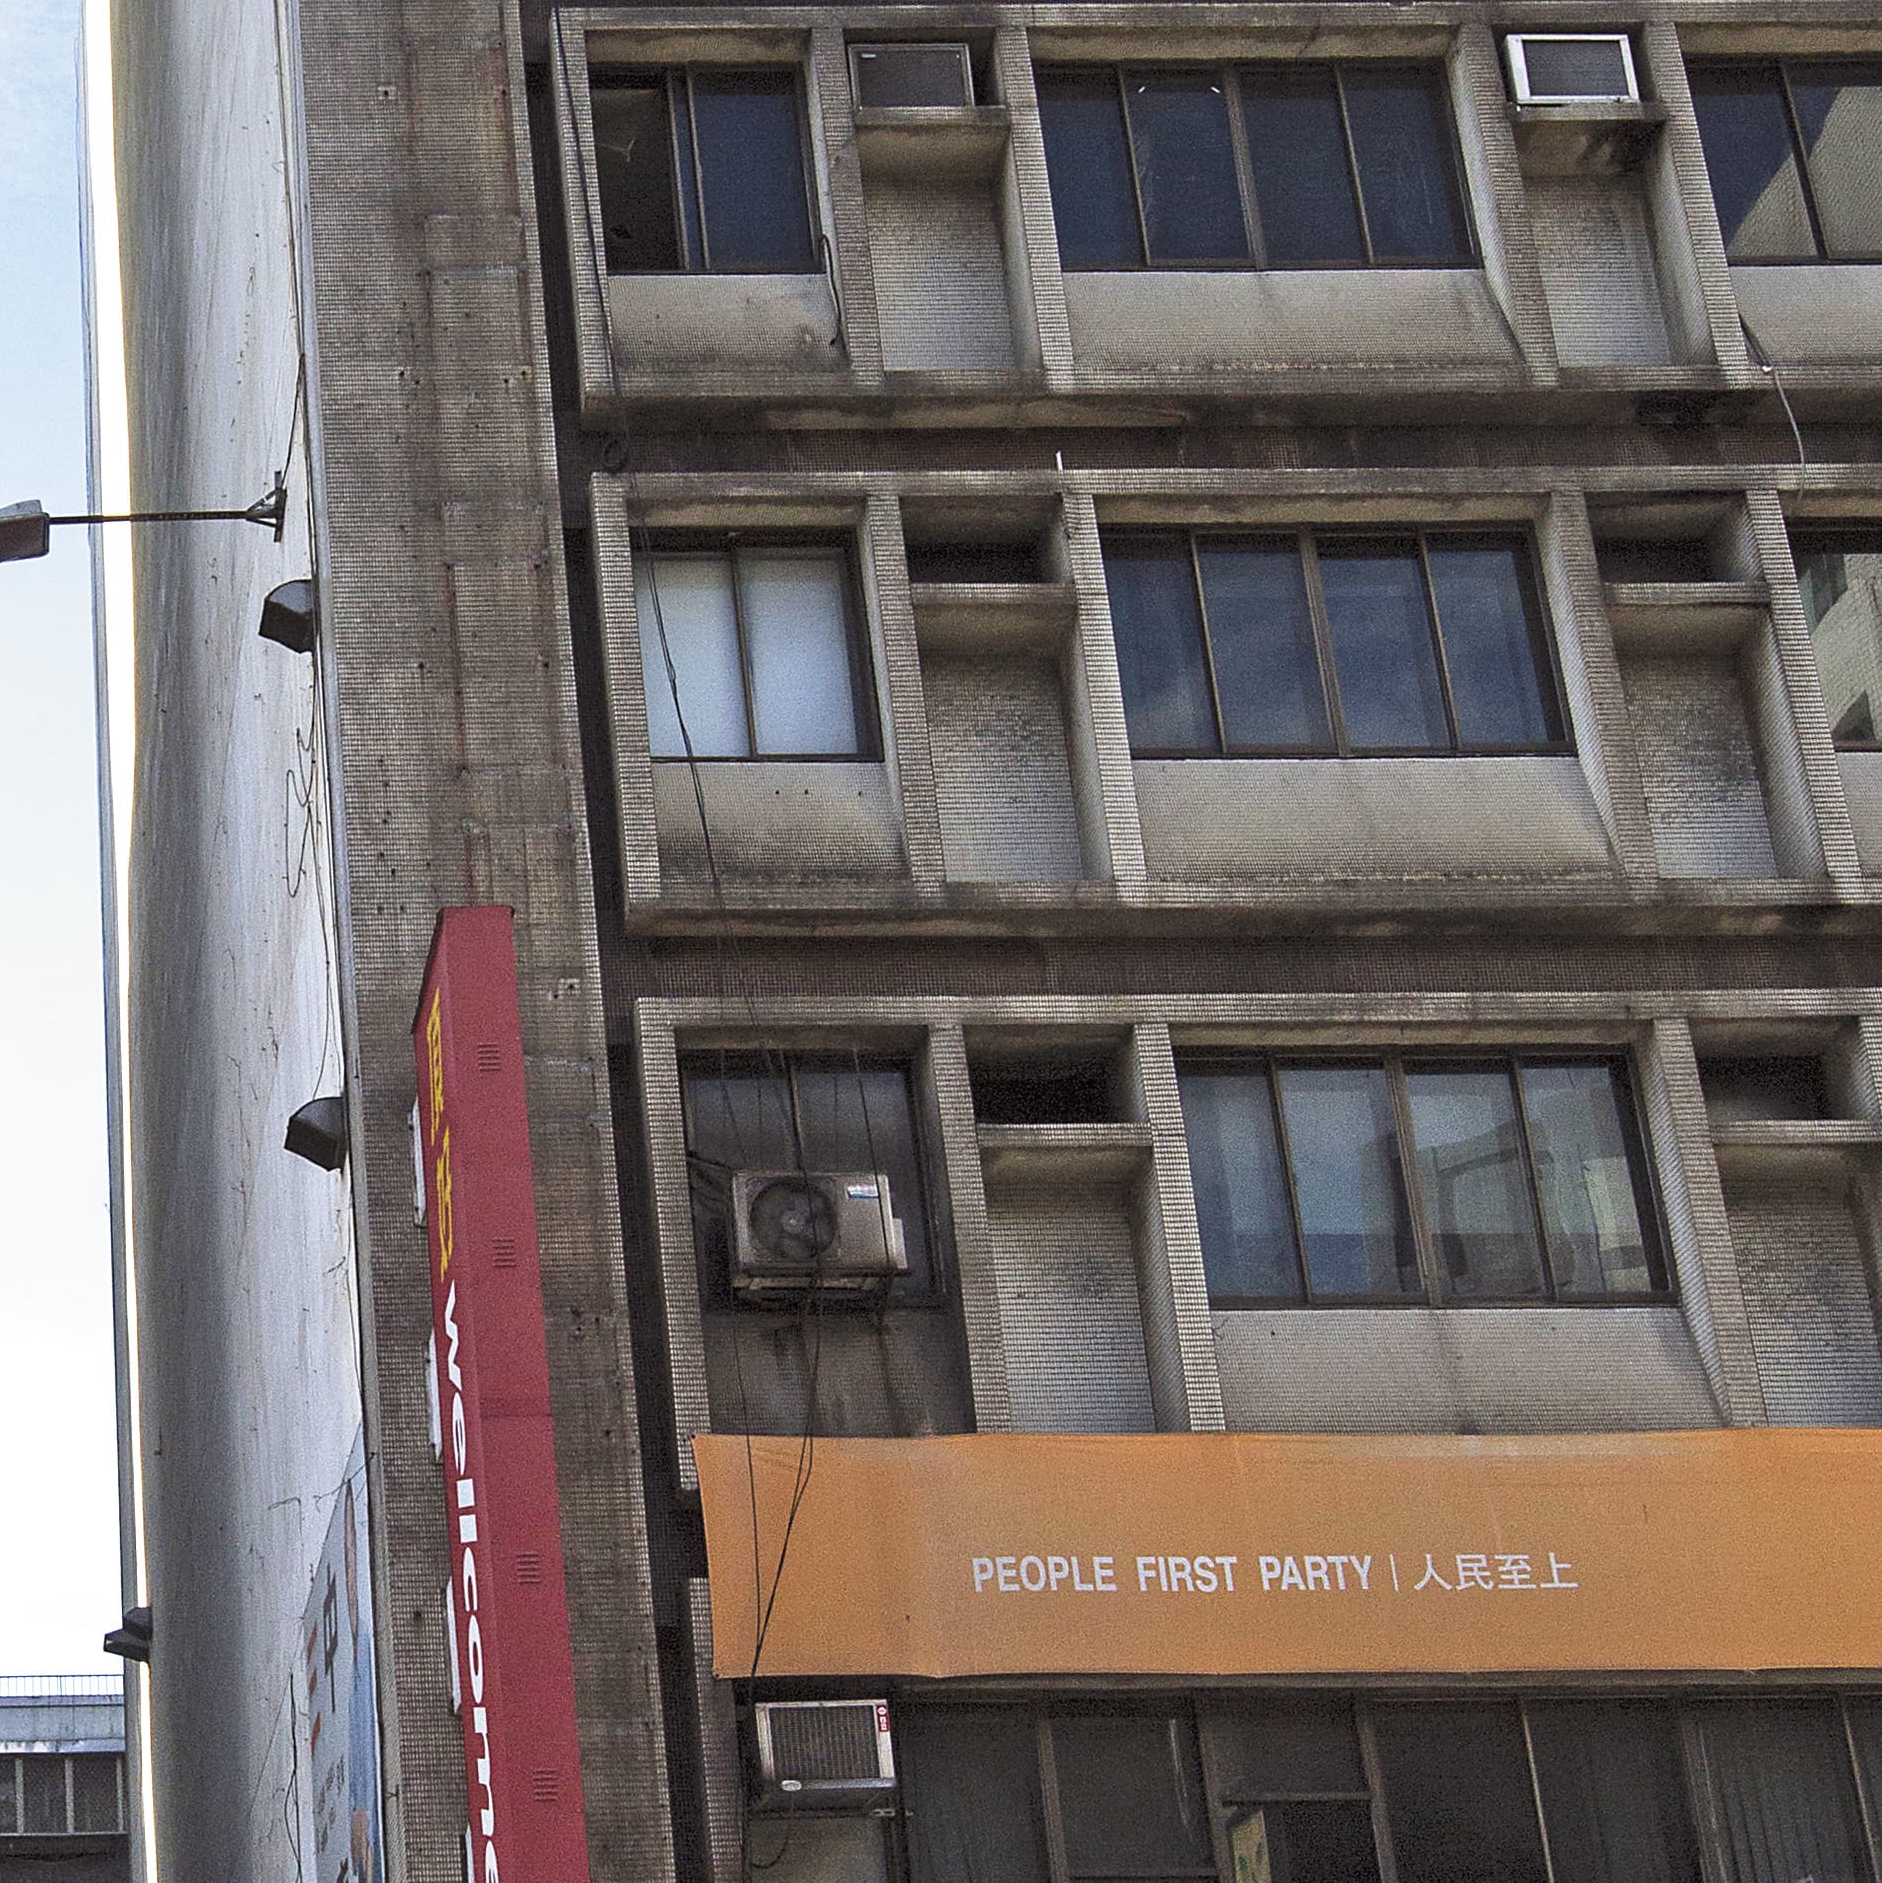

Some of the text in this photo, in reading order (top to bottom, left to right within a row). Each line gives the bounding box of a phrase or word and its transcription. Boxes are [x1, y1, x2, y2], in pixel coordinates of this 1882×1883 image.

[972, 1554, 1372, 1593] PEOPLE FIRST PARTY
[1414, 1552, 1579, 1592] 人民至上
